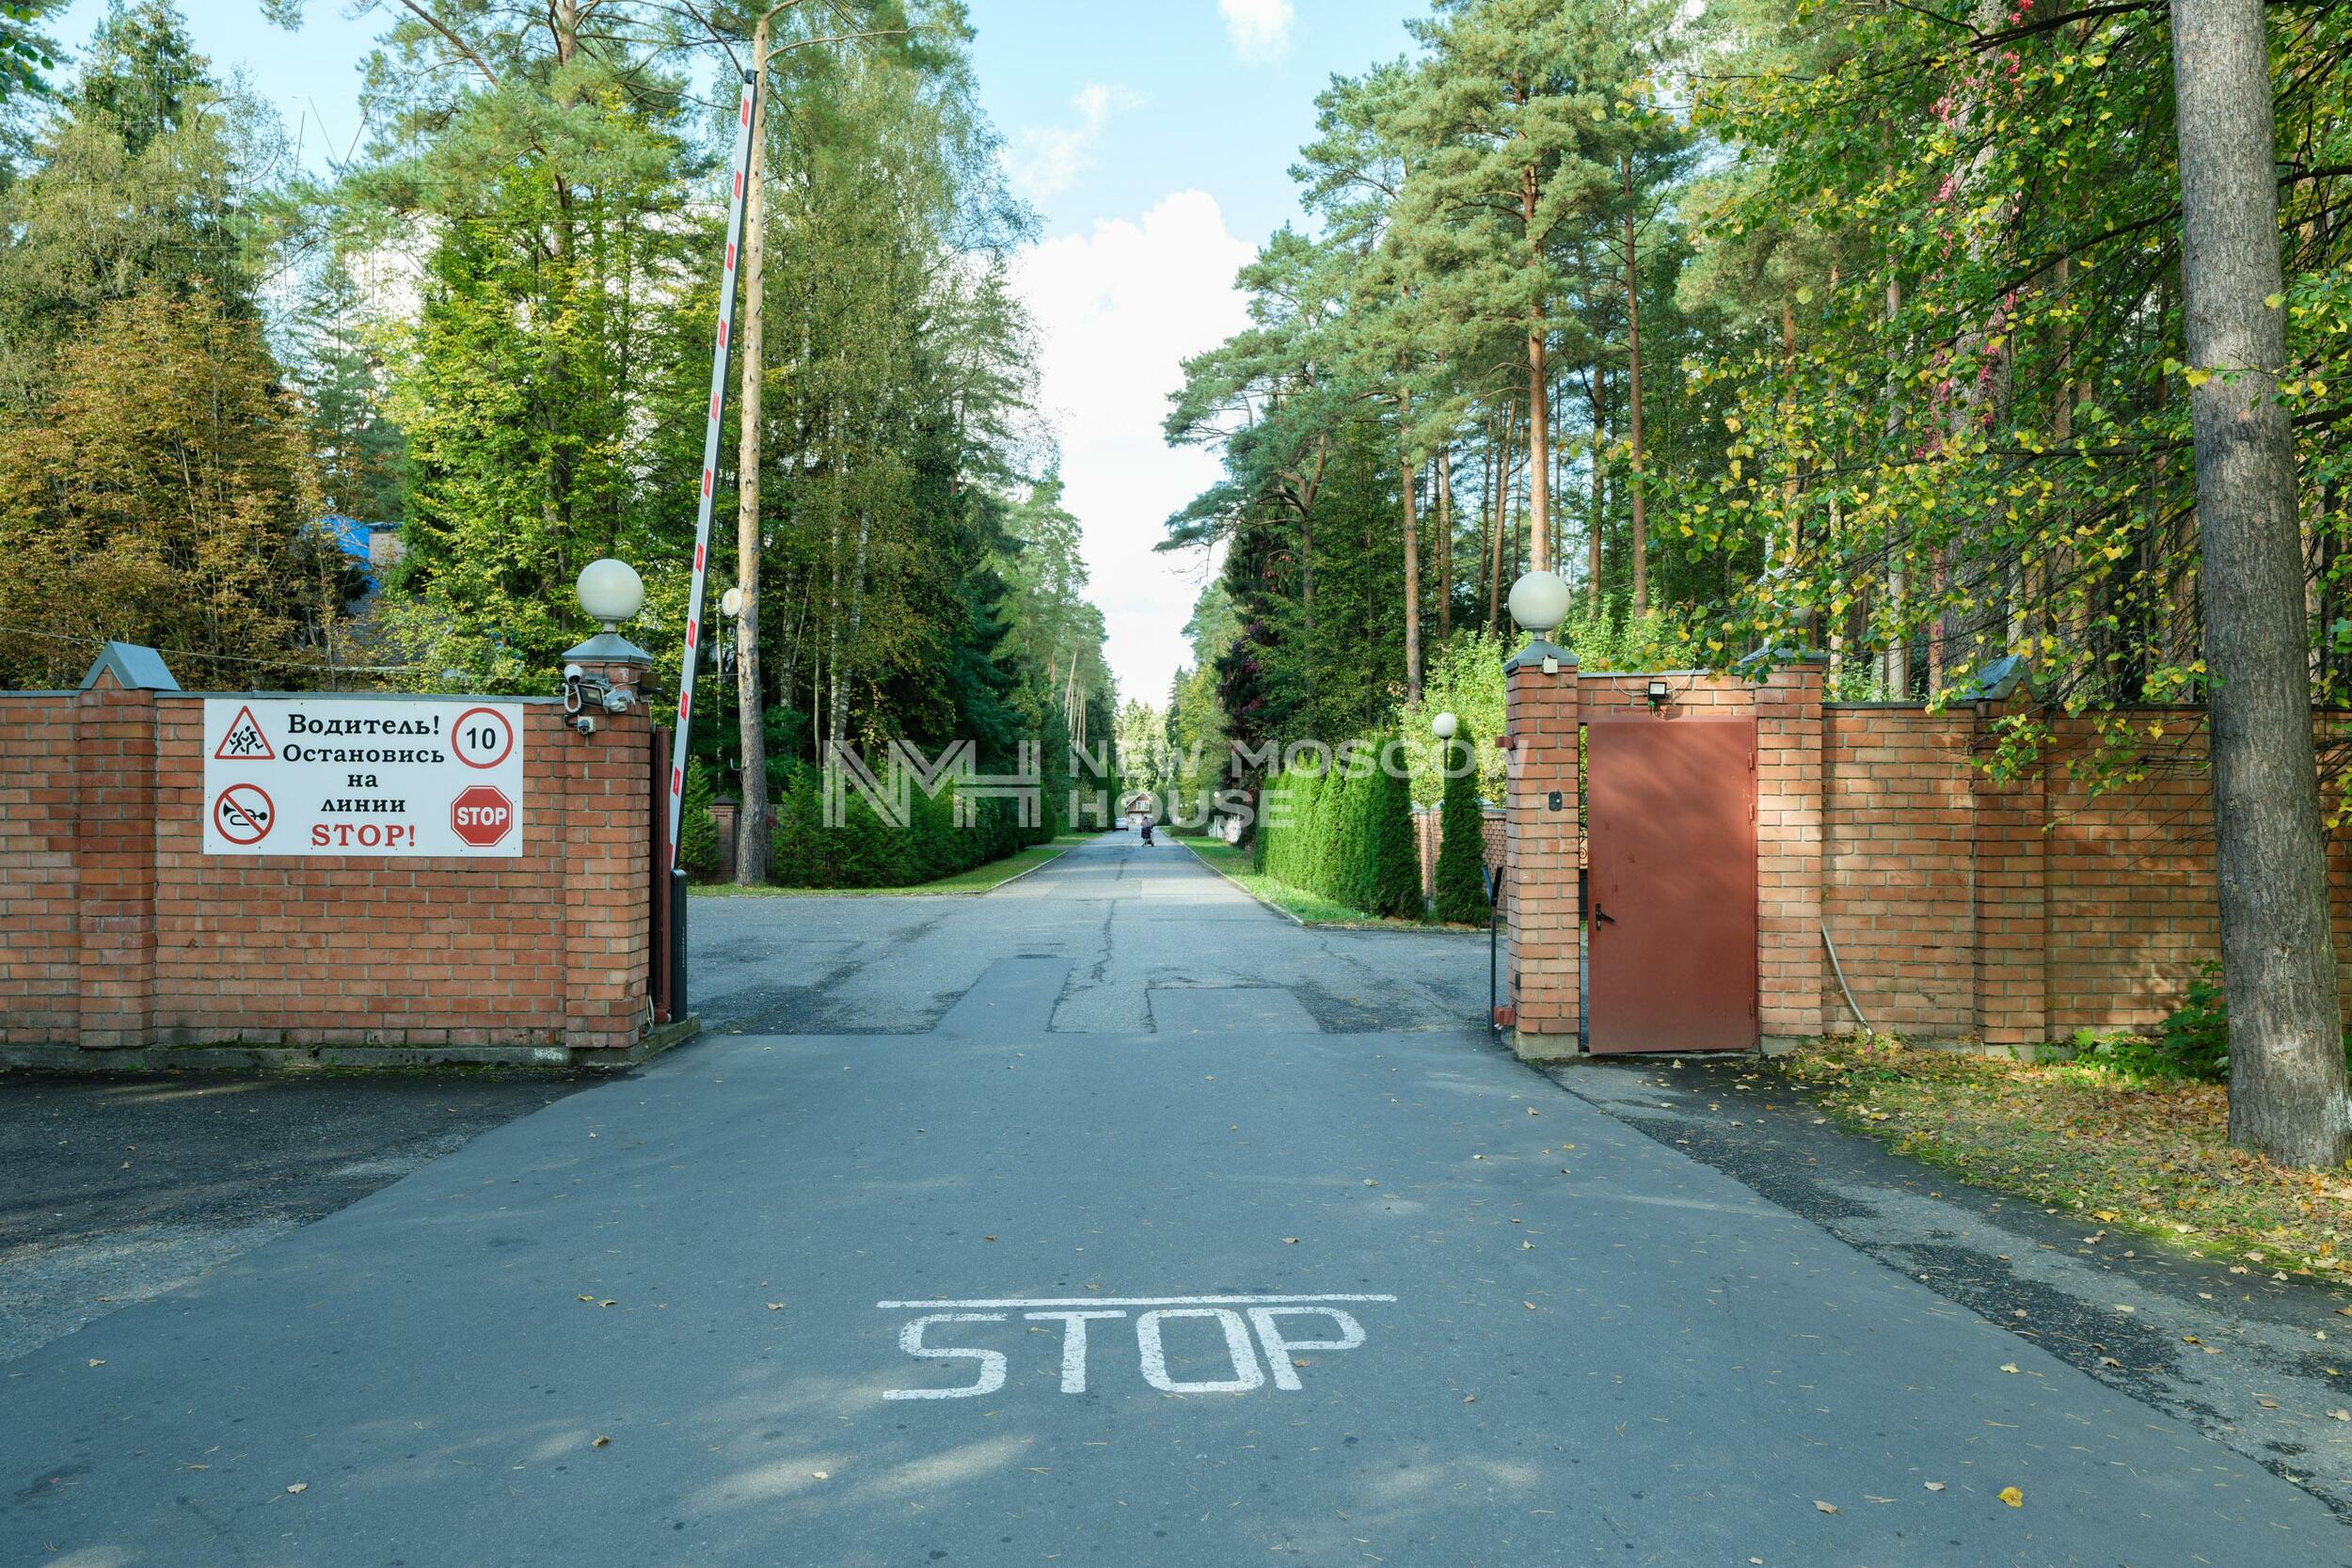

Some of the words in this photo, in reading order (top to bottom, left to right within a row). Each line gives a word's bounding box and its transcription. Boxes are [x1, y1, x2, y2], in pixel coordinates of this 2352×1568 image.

[288, 714, 439, 736] Водитель!
[466, 728, 496, 750] 10
[282, 744, 445, 763] Остановись
[347, 774, 378, 788] на
[321, 800, 405, 813] линии
[456, 807, 507, 826] STOP
[311, 824, 415, 847] STOP!
[882, 1307, 1367, 1401] STOP
